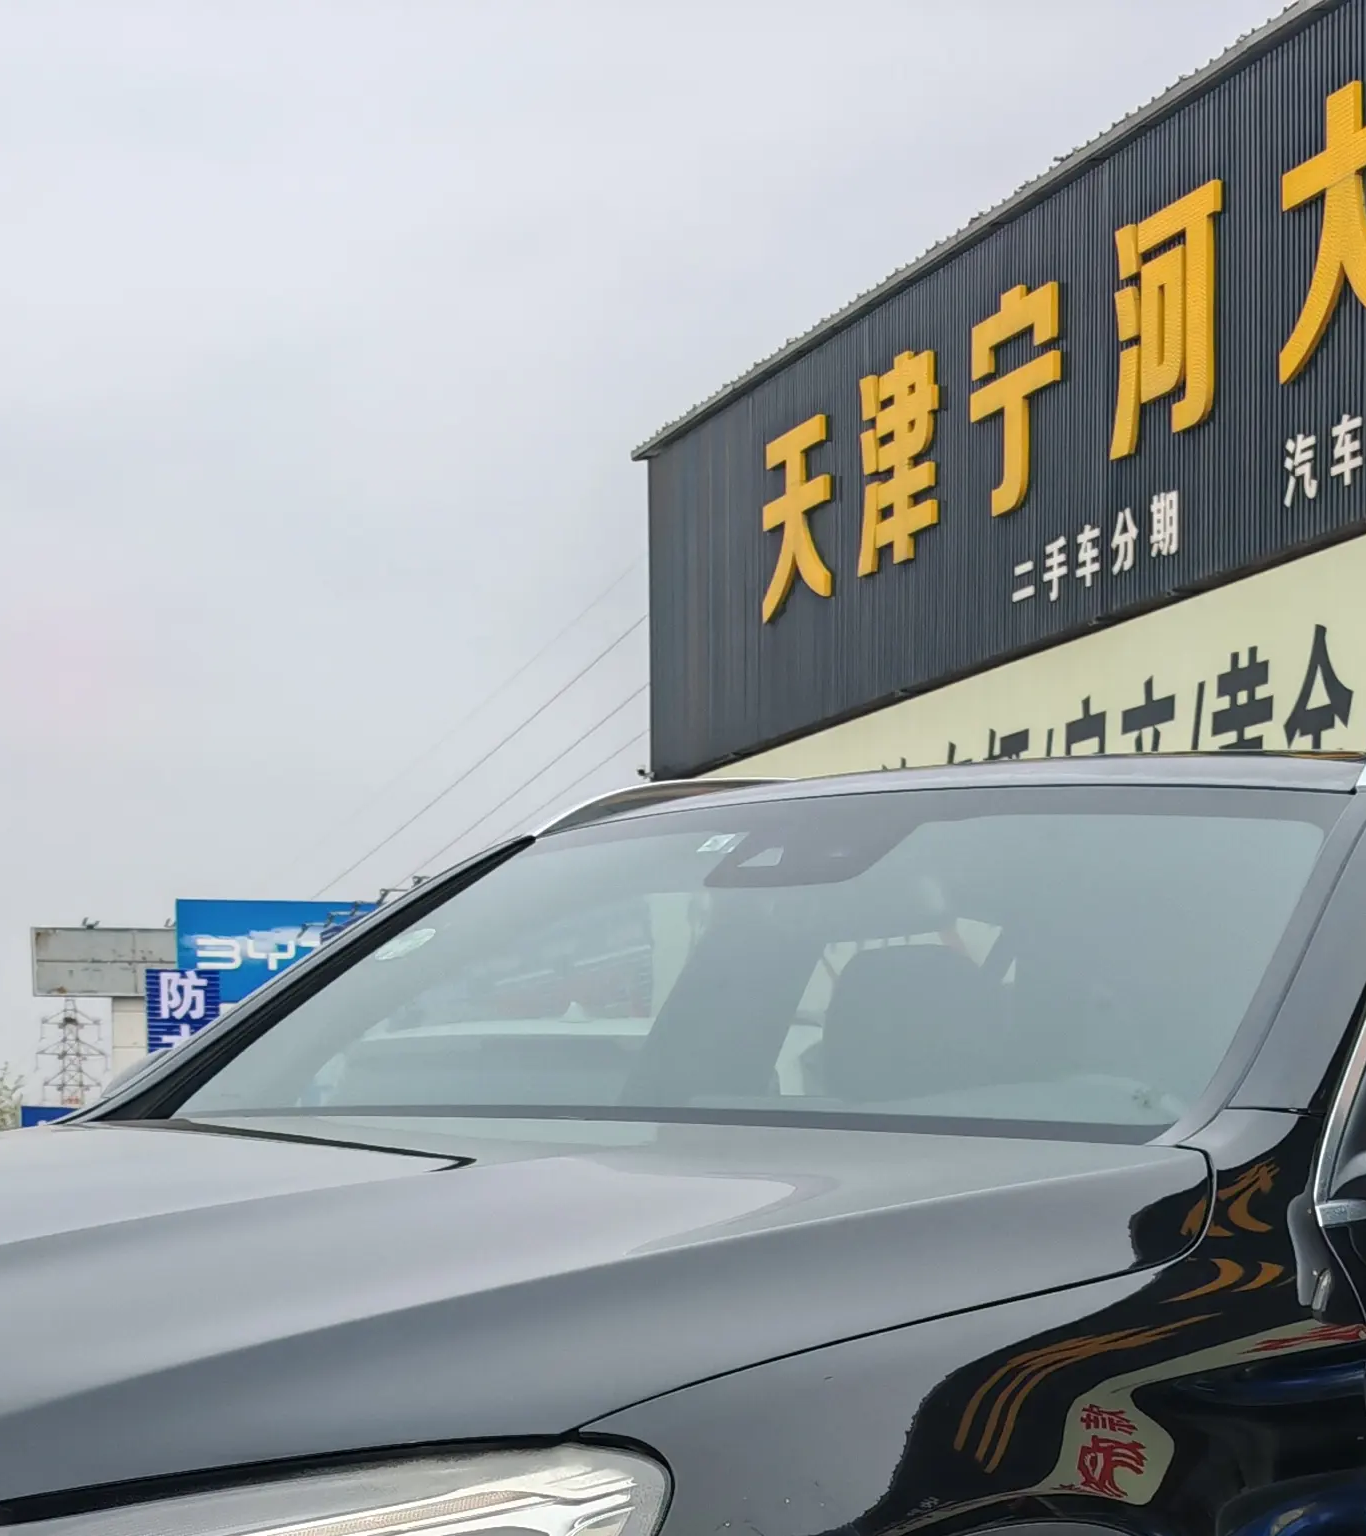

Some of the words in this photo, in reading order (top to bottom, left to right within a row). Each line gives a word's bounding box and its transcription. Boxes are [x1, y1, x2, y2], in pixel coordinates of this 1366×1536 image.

[1011, 491, 1181, 603] 二手车分期
[195, 936, 322, 971] BY
